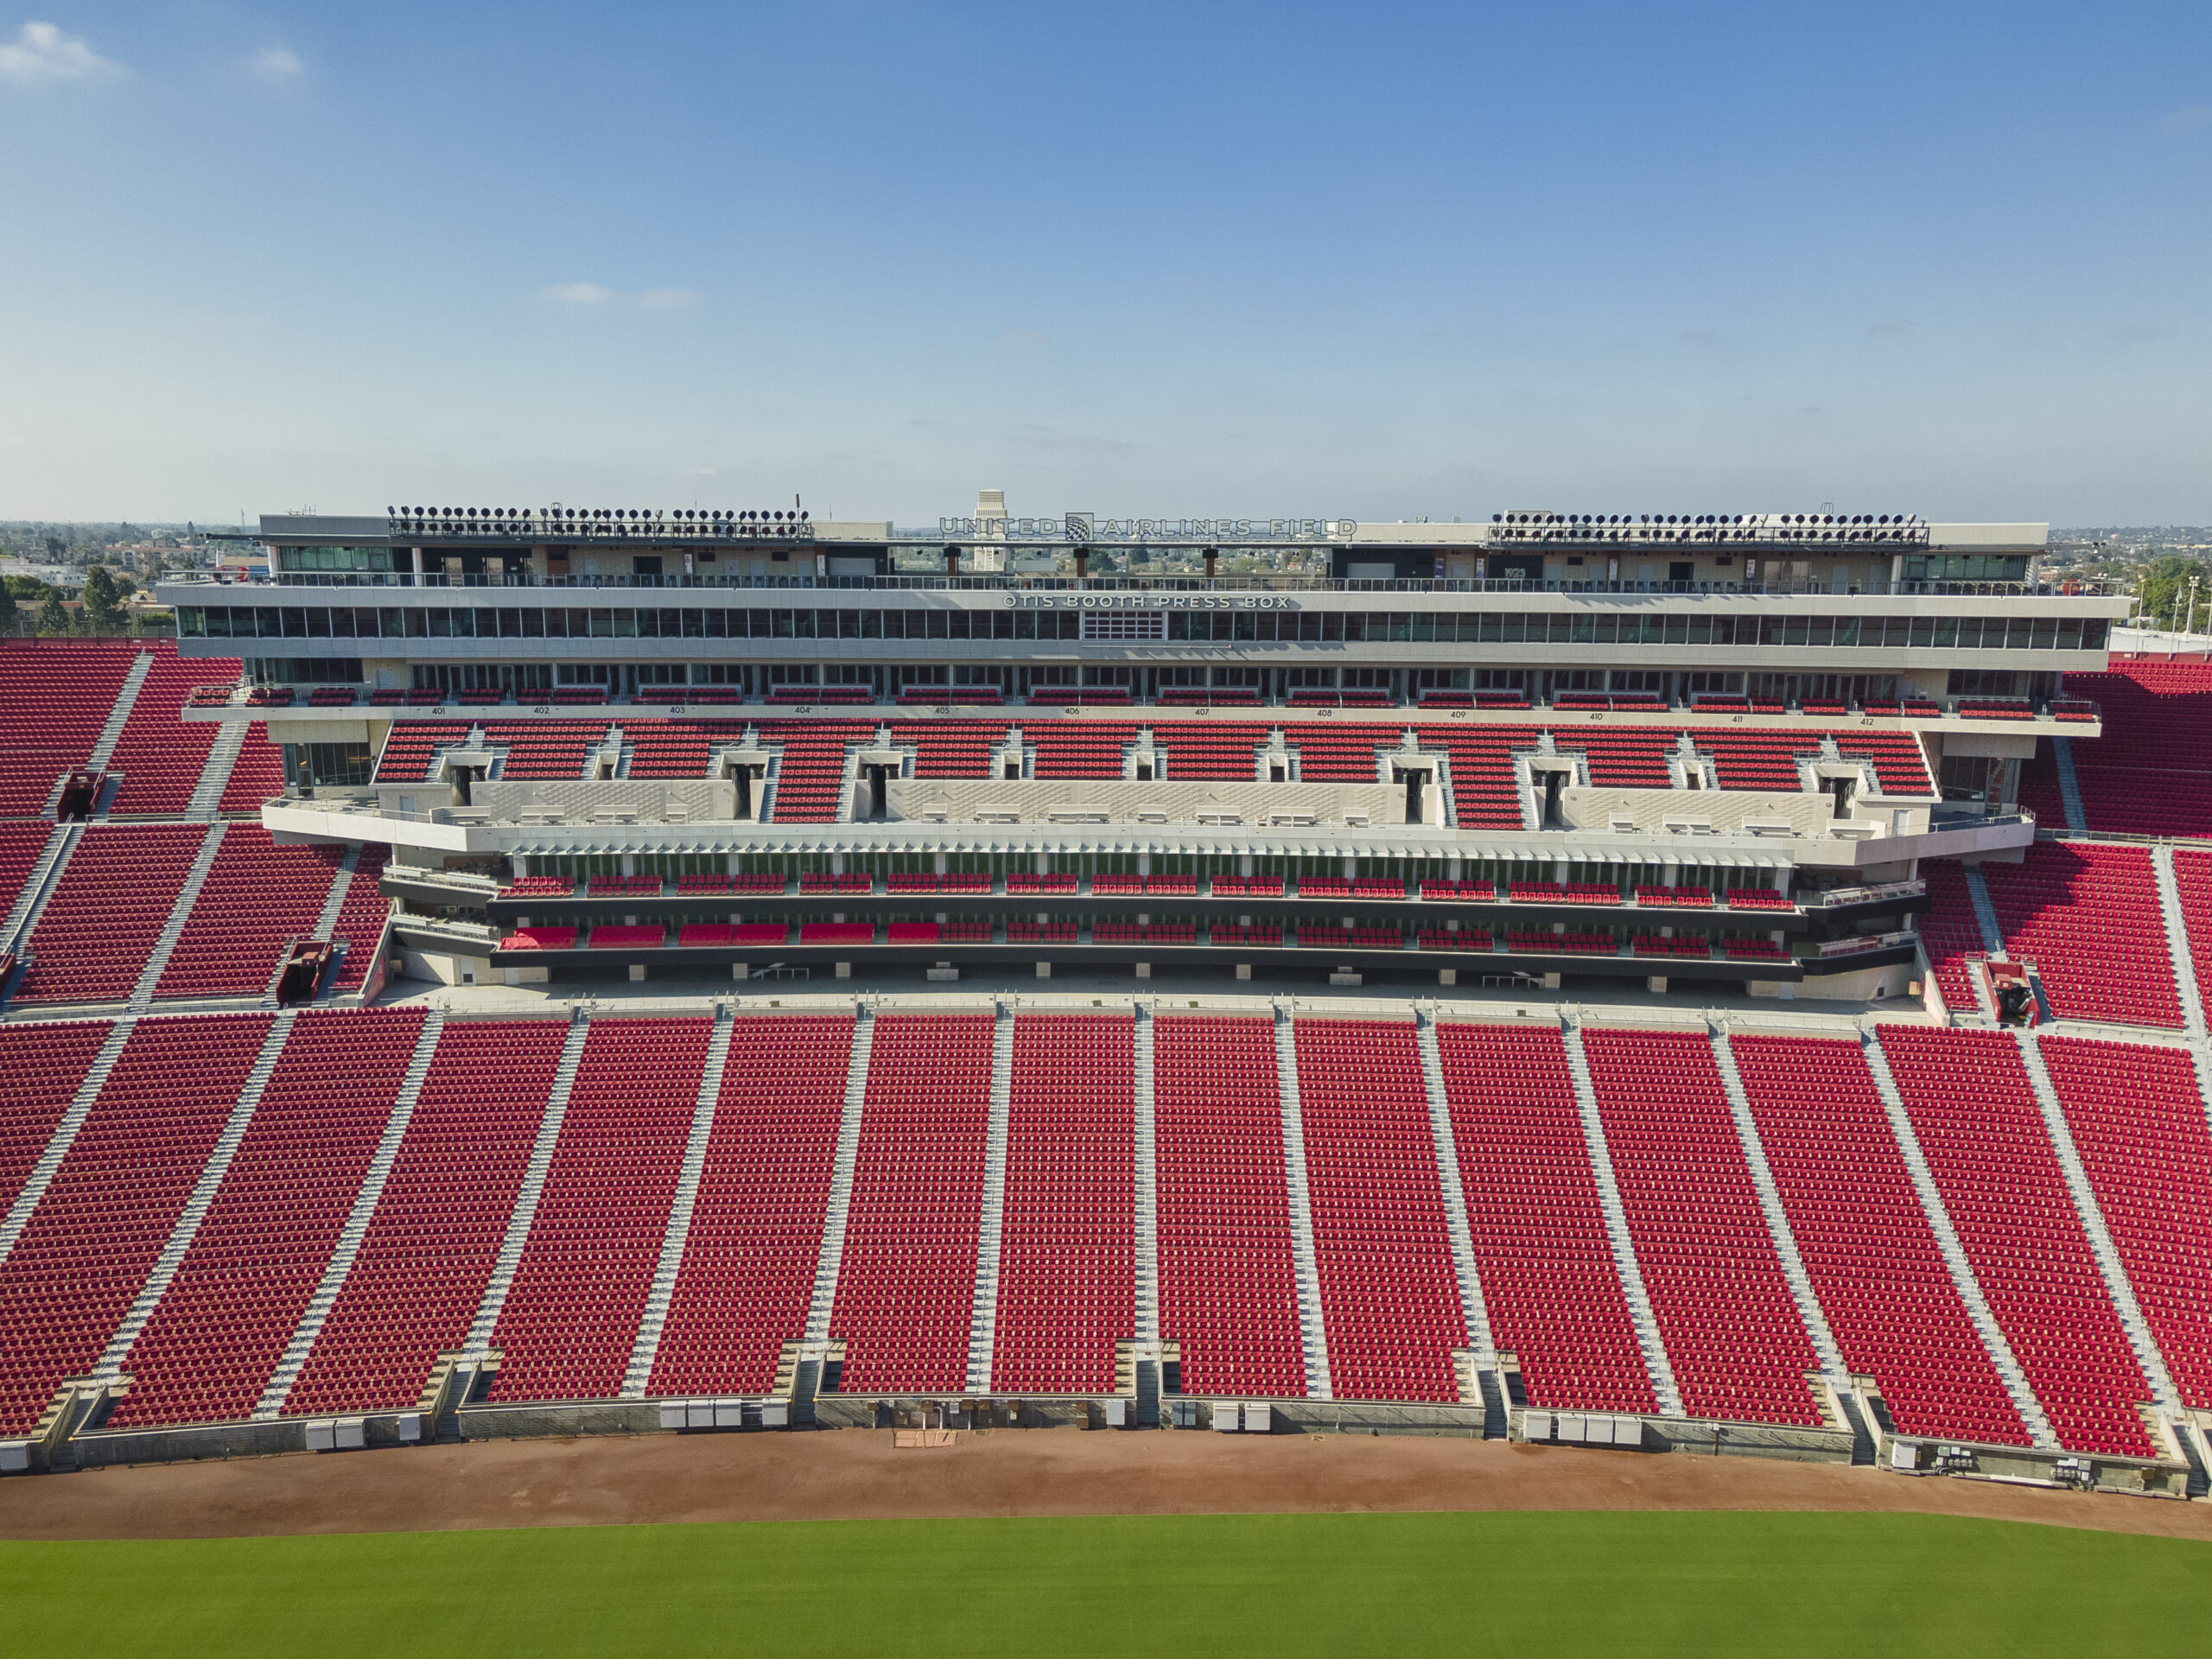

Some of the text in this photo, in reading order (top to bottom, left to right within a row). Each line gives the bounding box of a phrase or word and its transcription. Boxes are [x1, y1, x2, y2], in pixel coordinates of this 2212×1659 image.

[939, 518, 1357, 537] UNITED AIRLINES FIELD
[1002, 595, 1289, 608] OTIS BOOTH PRESS BOX
